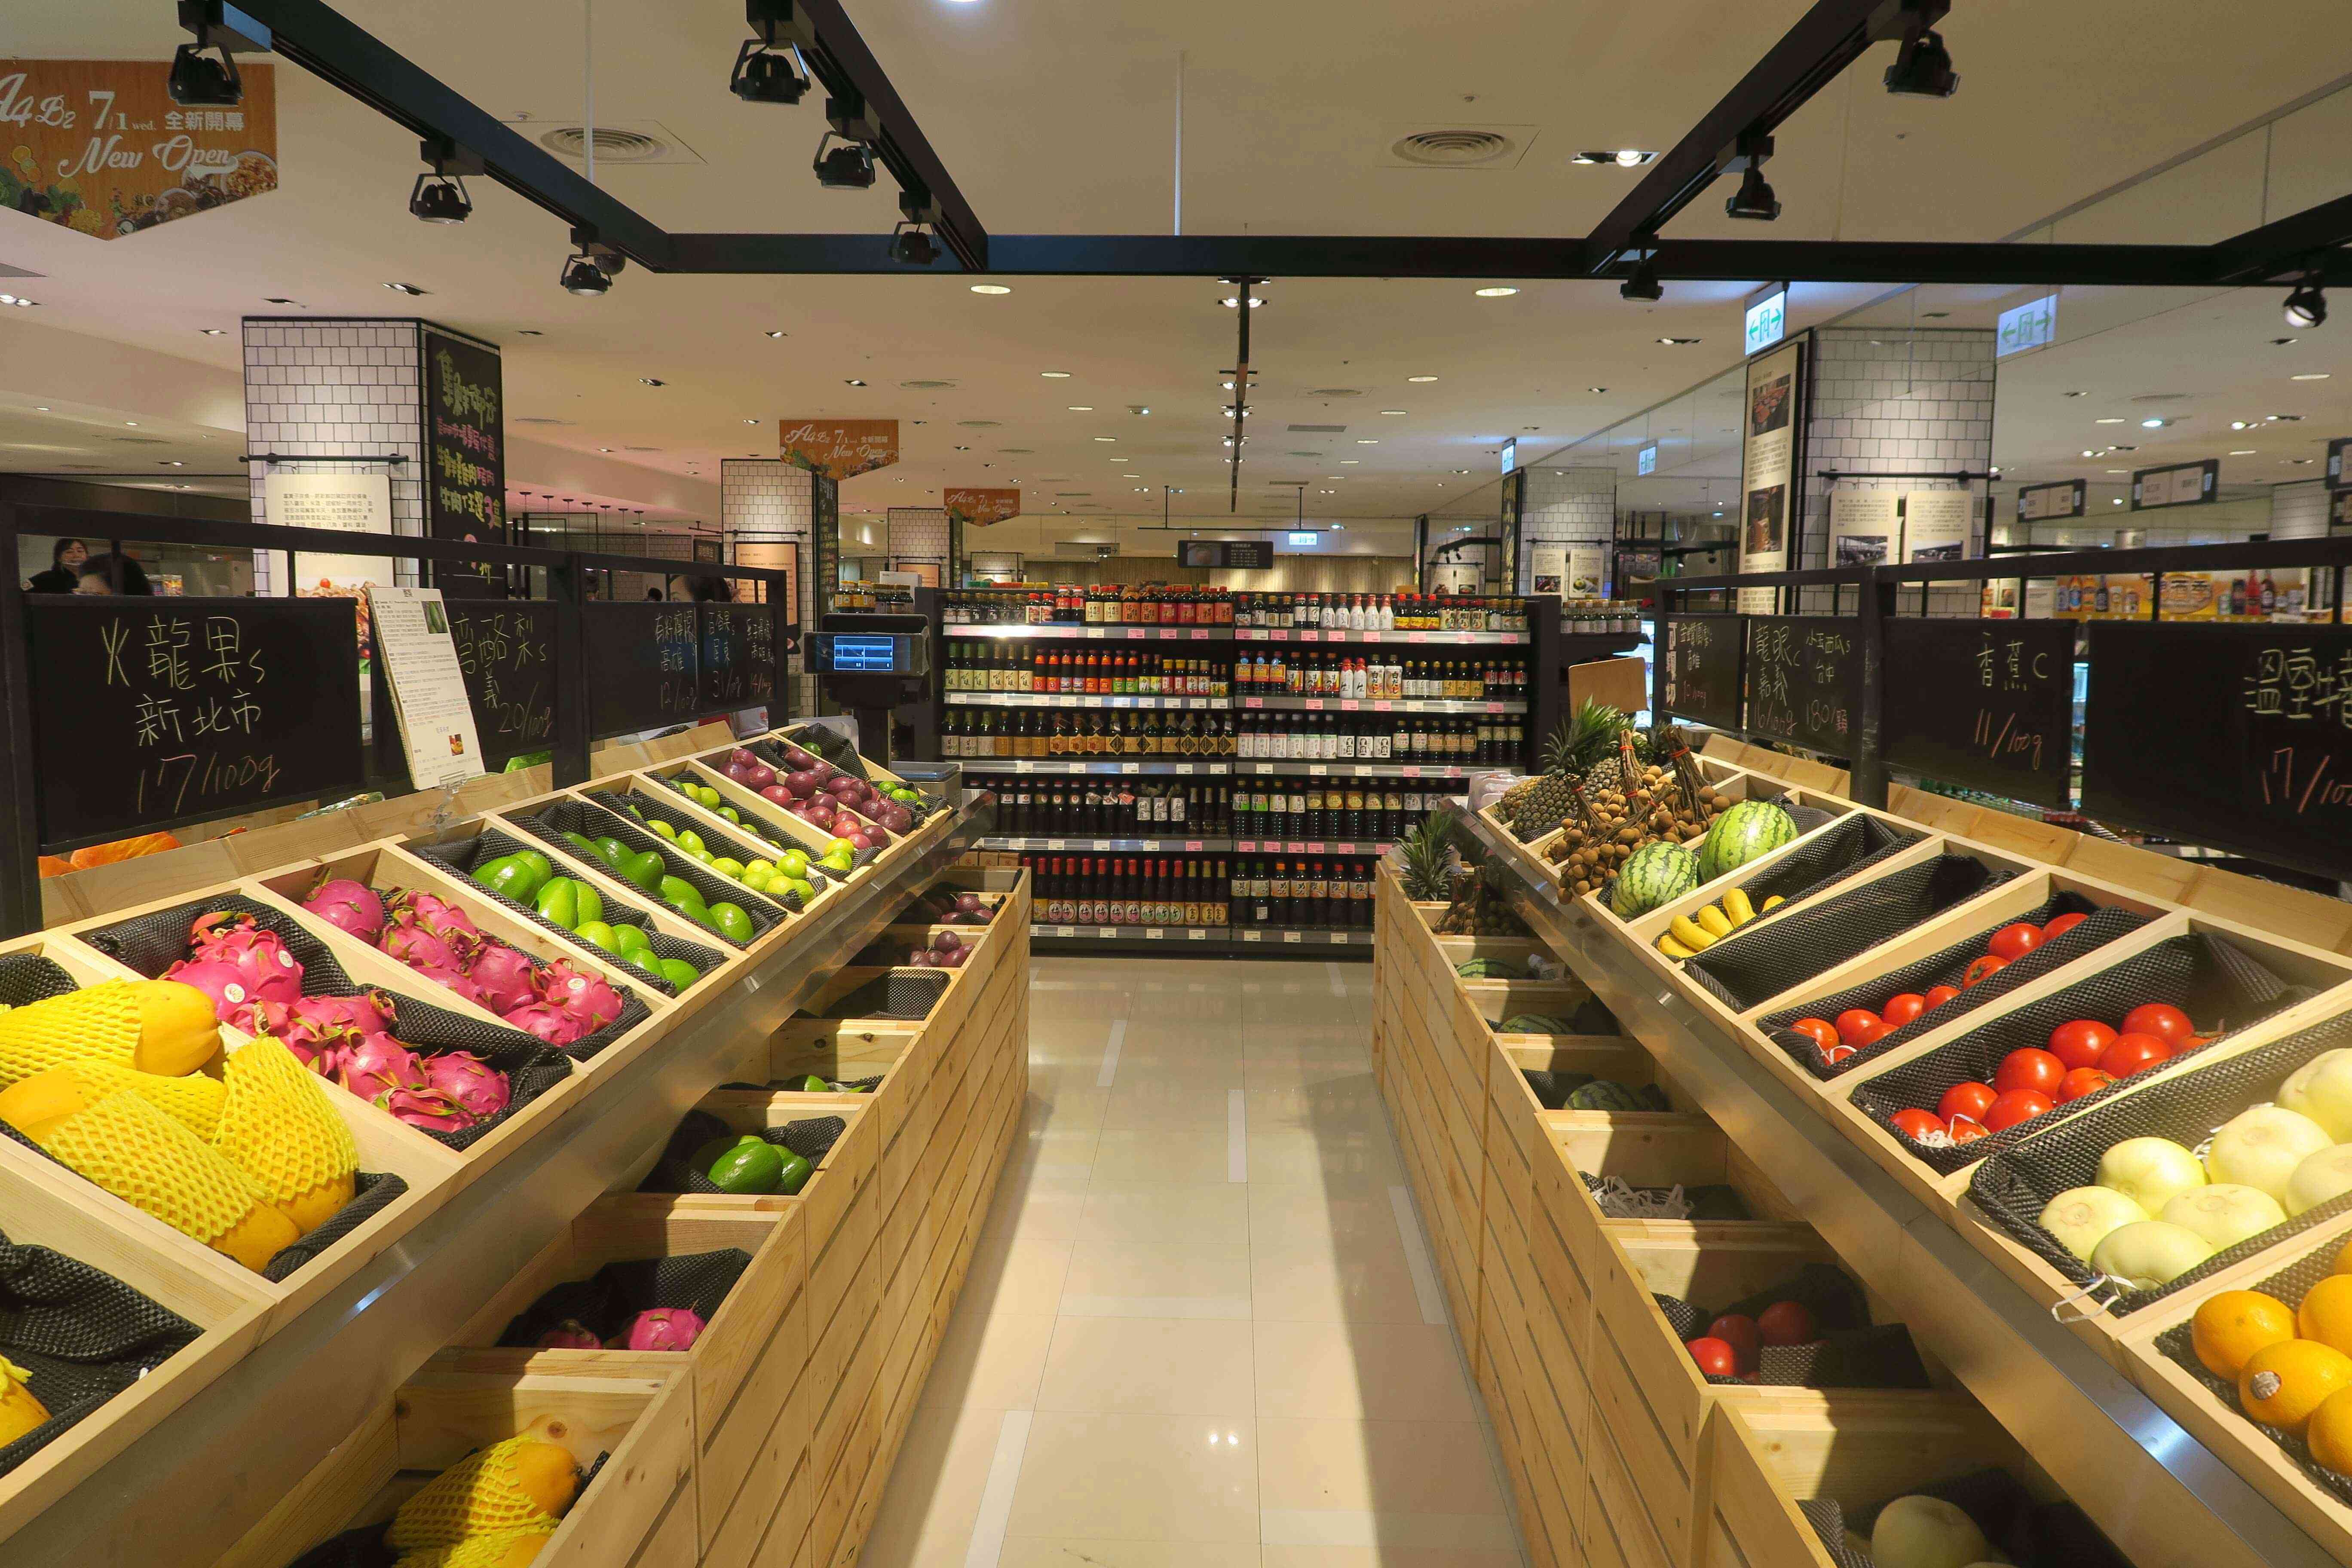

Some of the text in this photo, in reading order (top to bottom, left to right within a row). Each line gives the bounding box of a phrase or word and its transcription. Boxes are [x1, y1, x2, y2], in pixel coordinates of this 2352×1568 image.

[165, 110, 245, 132] 全新開幕
[58, 135, 239, 178] New Open
[824, 444, 887, 460] New Open
[136, 689, 261, 746] 新北市
[138, 752, 280, 814] 17/100g
